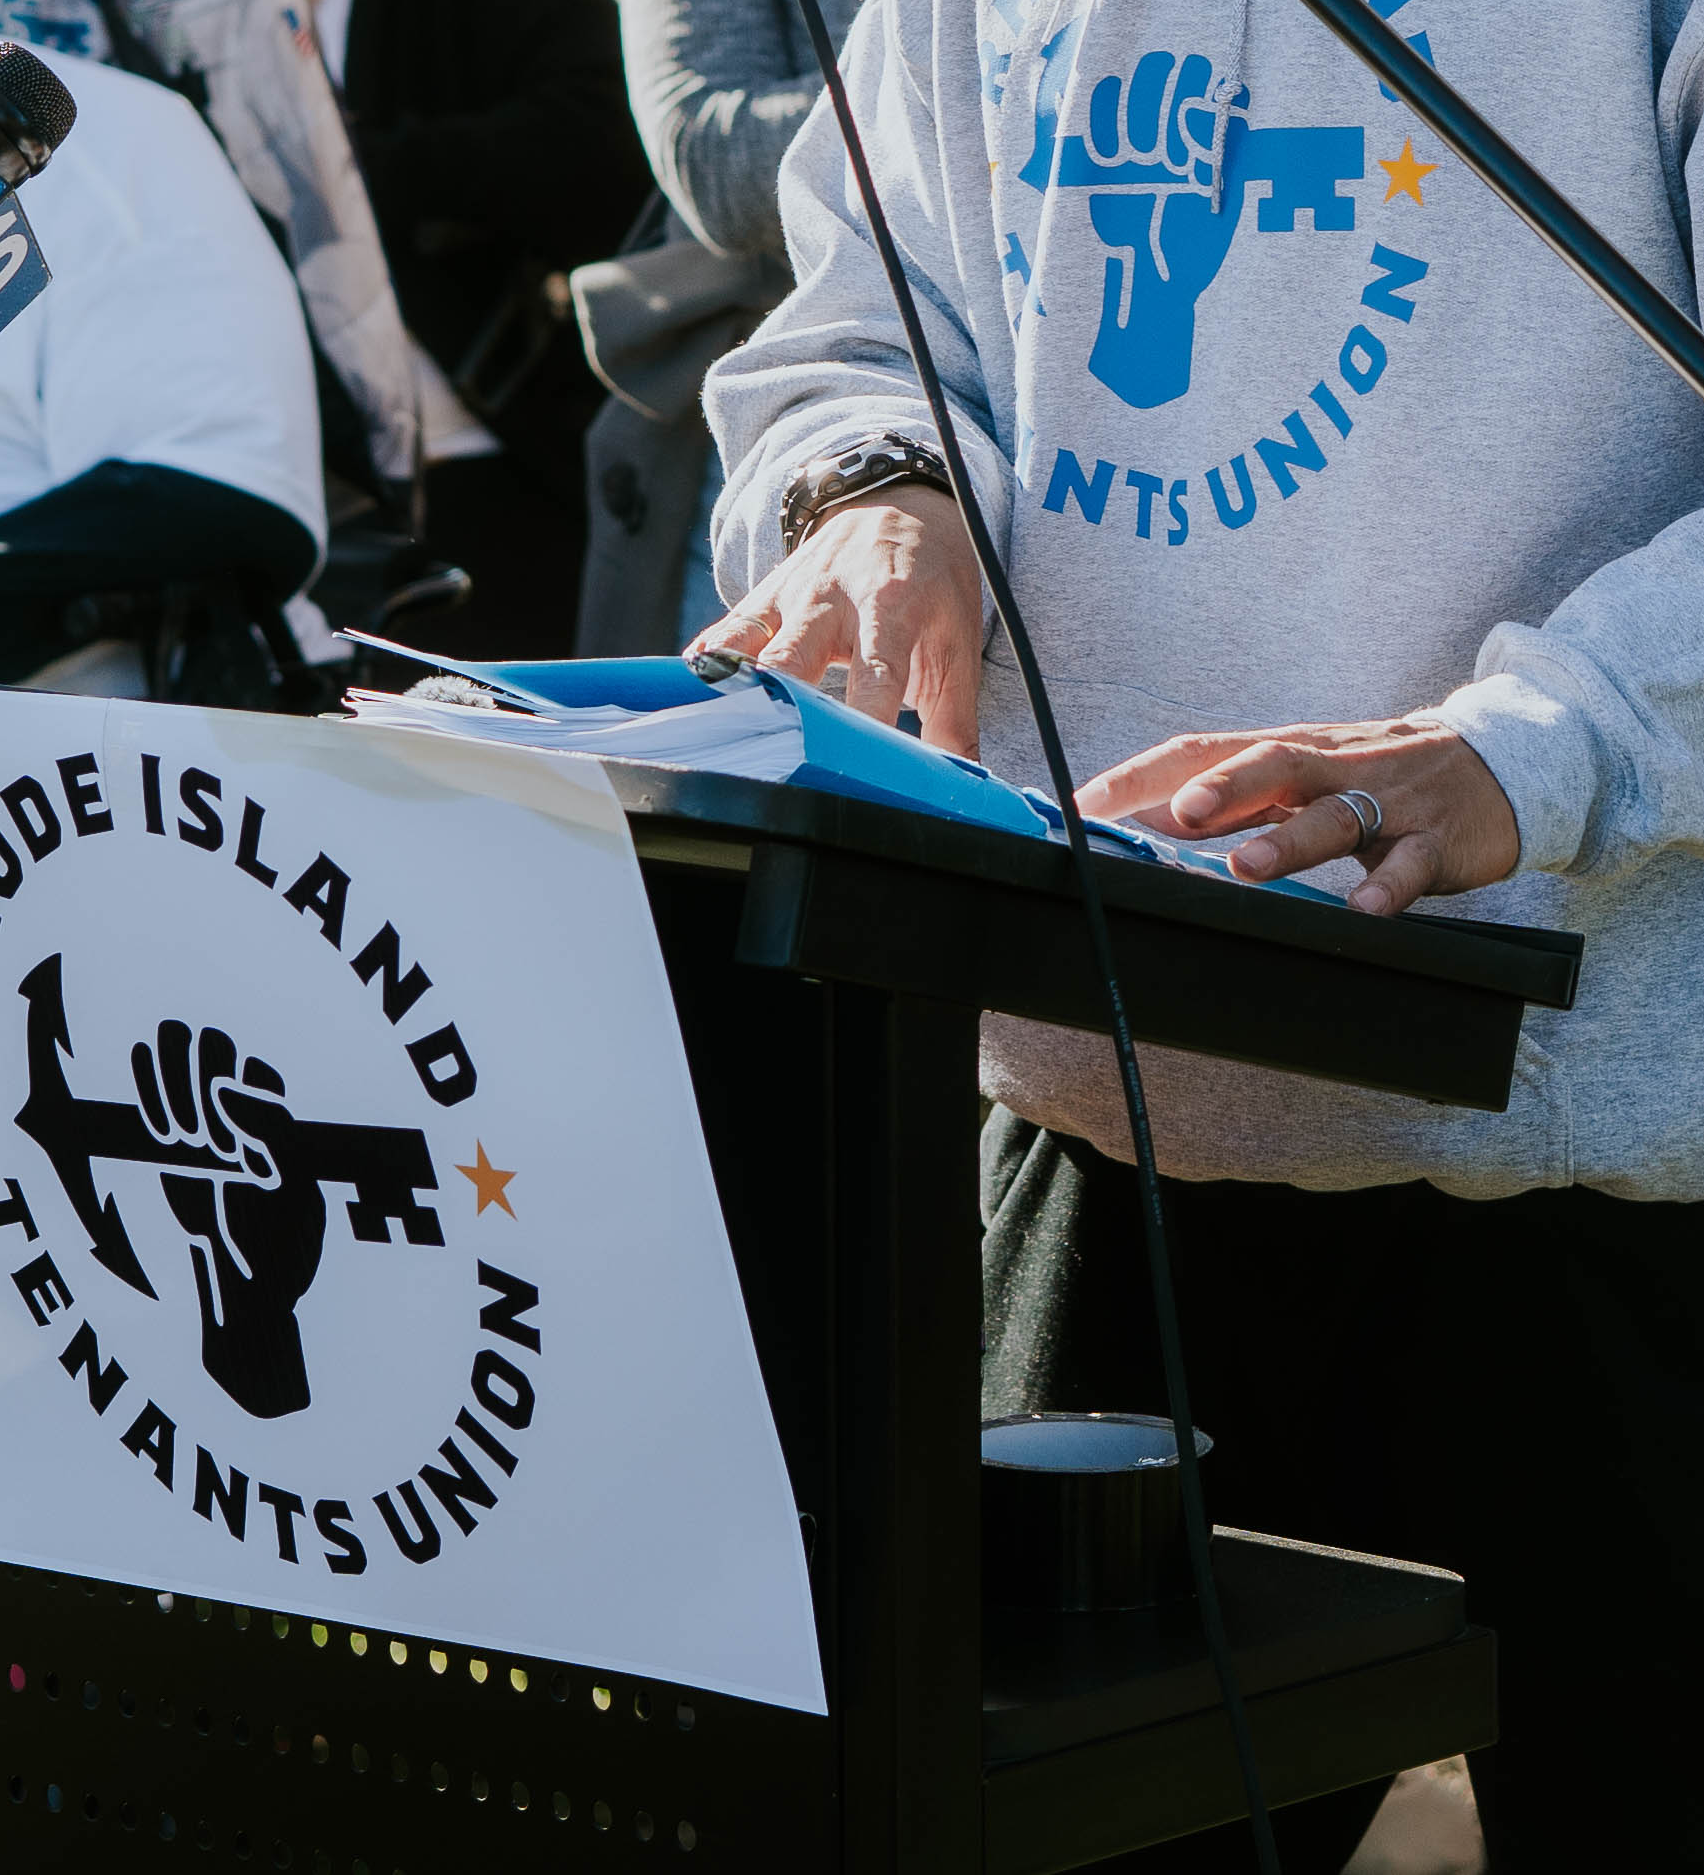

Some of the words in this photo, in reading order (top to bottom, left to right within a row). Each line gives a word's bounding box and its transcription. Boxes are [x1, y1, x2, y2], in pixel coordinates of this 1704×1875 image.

[1205, 241, 1430, 531] UNION
[140, 752, 479, 1109] ISLAND
[371, 1257, 543, 1566] UNION
